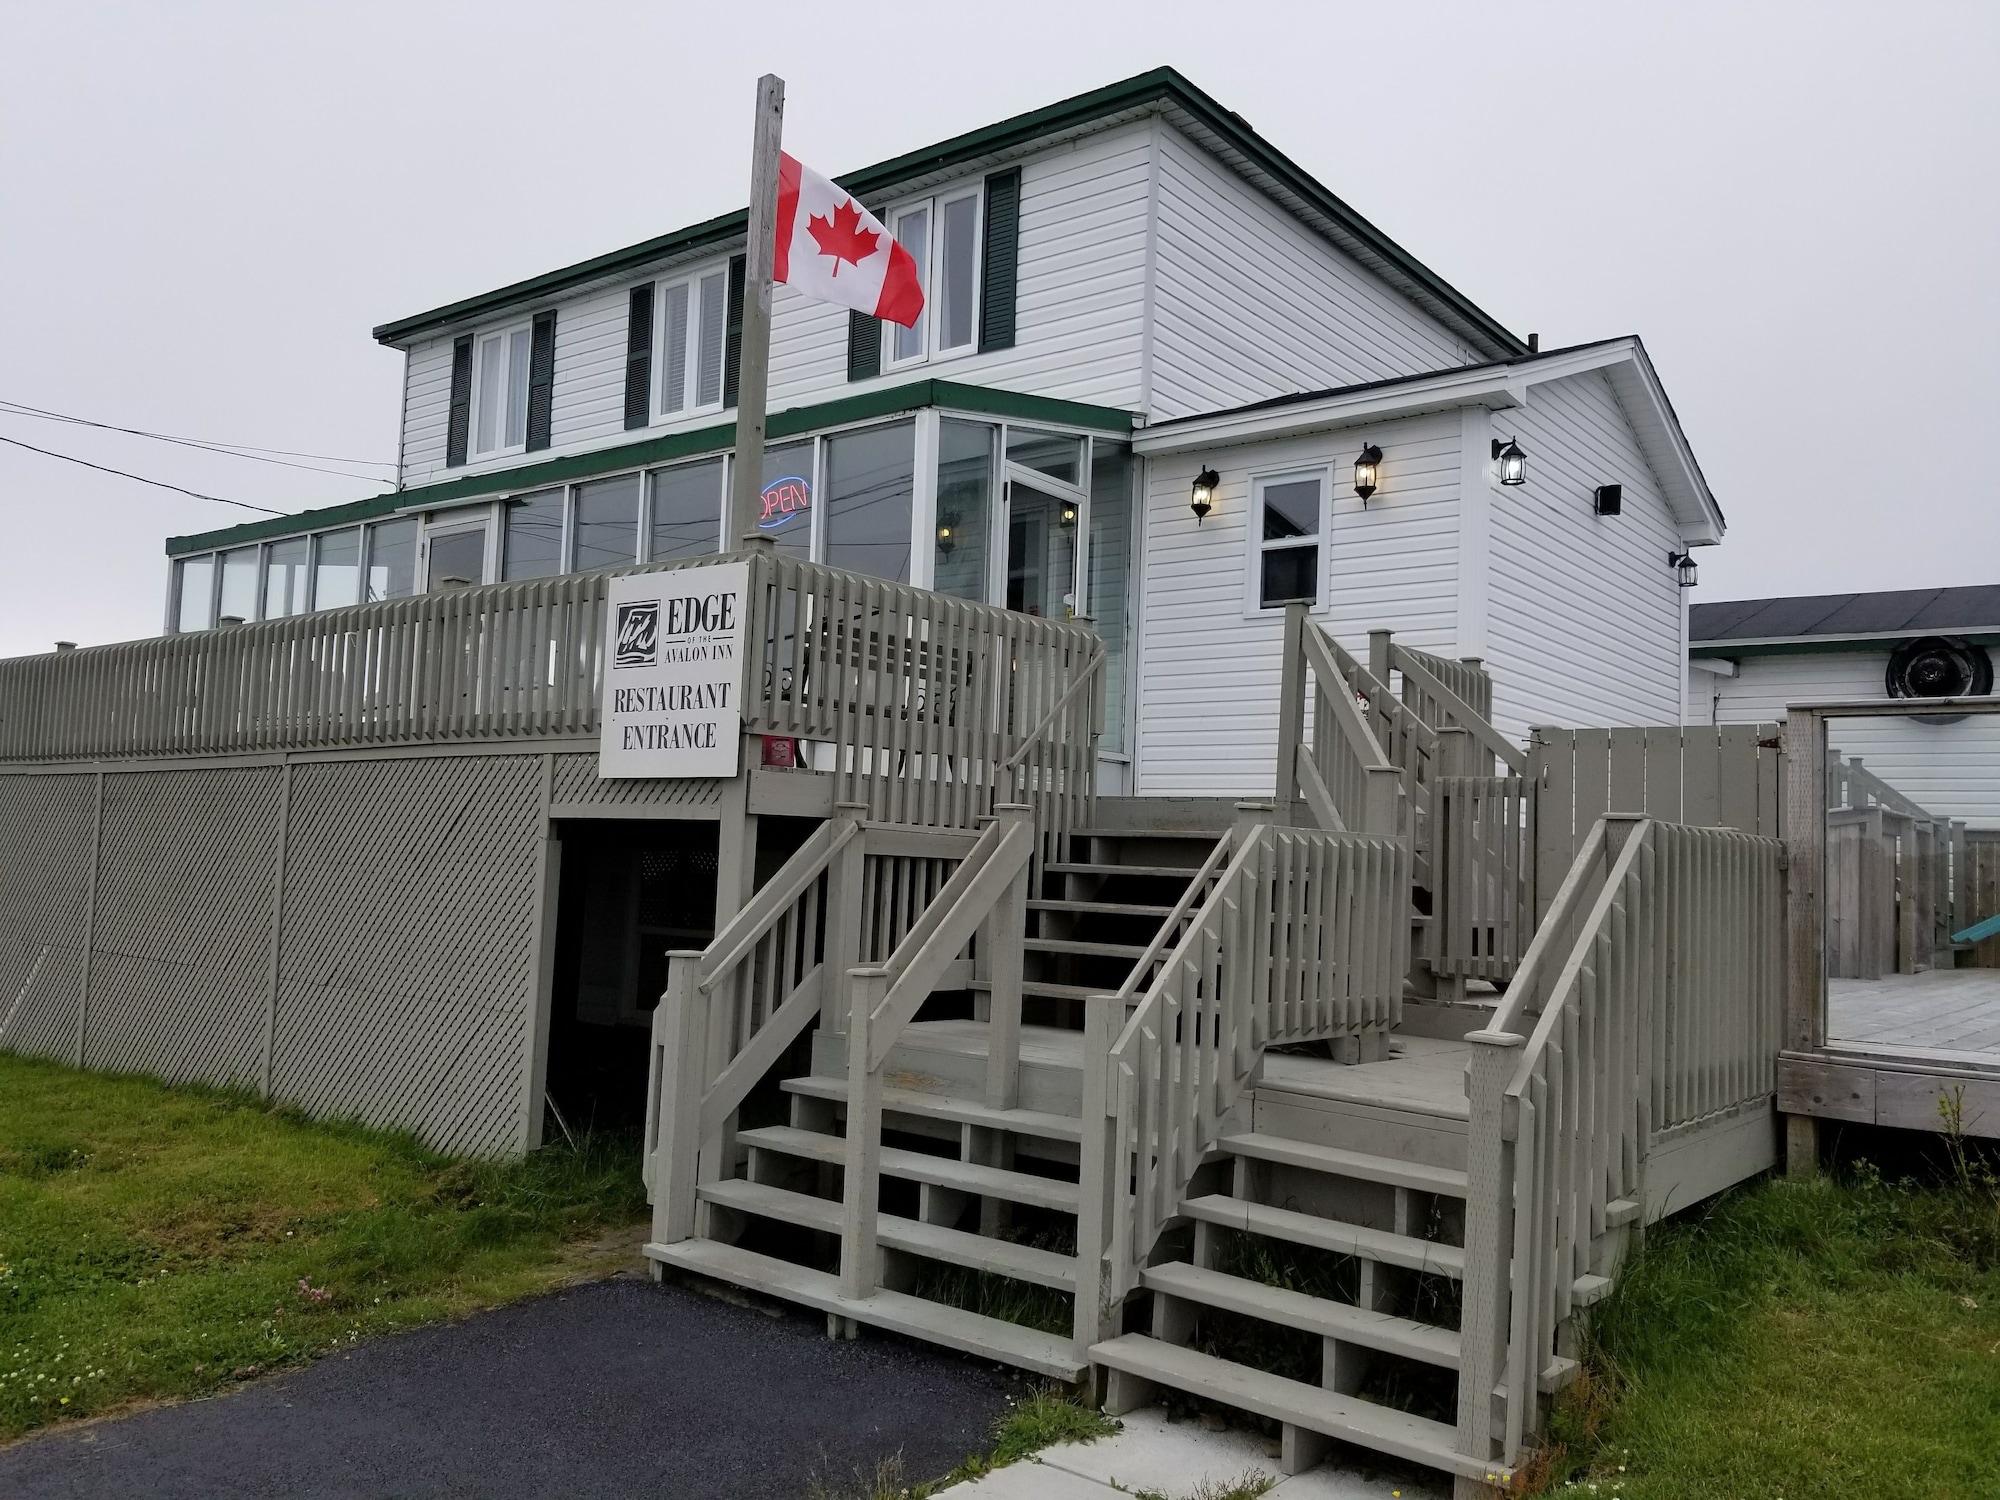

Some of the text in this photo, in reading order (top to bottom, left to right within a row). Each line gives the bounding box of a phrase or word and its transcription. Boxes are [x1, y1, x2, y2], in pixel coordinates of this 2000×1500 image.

[666, 593, 736, 635] EDGE
[699, 635, 711, 643] THE
[664, 644, 734, 663] AVALON INN
[614, 683, 731, 713] RESTAURANT
[623, 723, 717, 750] ENTRANCE
